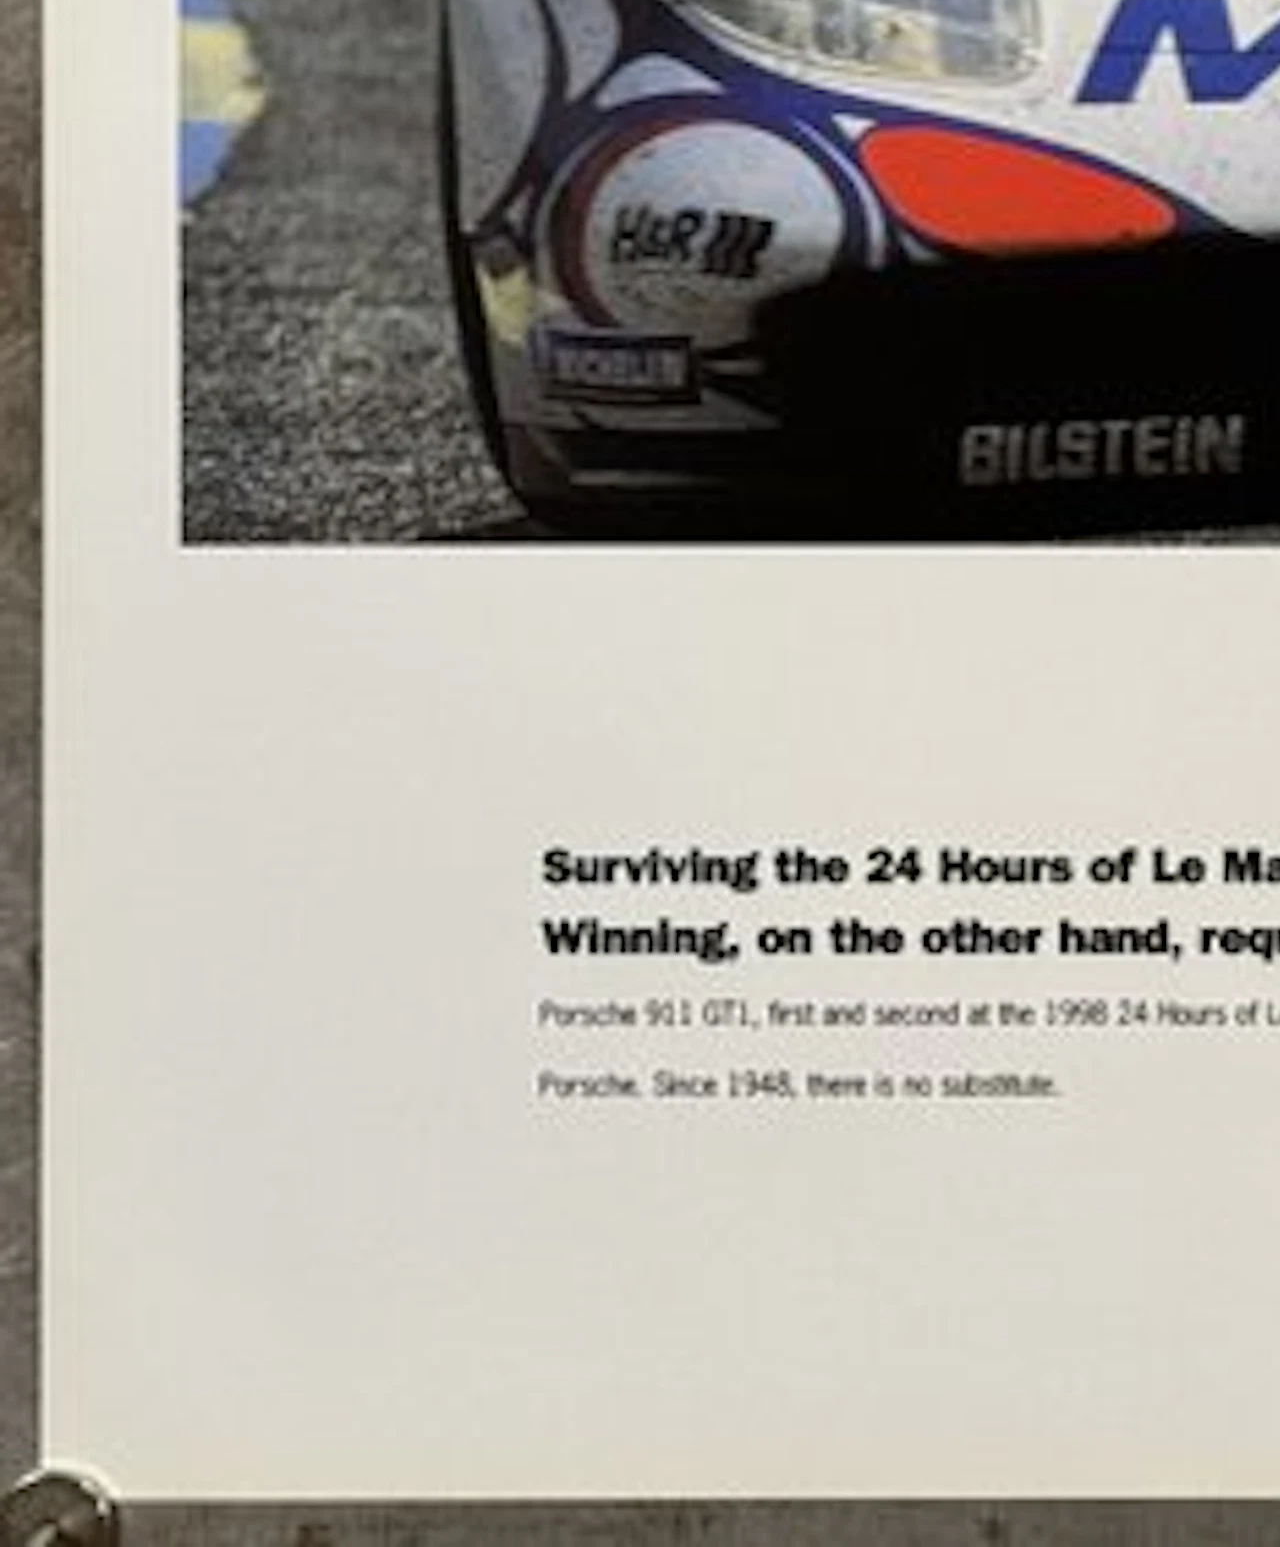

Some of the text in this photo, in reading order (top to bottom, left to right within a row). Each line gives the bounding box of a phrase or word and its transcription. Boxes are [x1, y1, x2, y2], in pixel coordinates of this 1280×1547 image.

[957, 414, 1245, 486] BILSTEIN
[542, 846, 761, 895] Surviving
[772, 846, 851, 886] the
[865, 845, 924, 885] 24
[938, 846, 1075, 885] Hours
[1086, 845, 1139, 885] of
[1151, 846, 1208, 886] Le
[540, 916, 742, 966] Winning,
[756, 926, 814, 956] on
[827, 916, 906, 956] the
[920, 917, 1044, 956] other
[1057, 917, 1183, 962] hand,
[538, 998, 638, 1028] Porsche
[644, 998, 693, 1028] 911
[767, 998, 816, 1028] first
[822, 999, 867, 1028] and
[873, 999, 962, 1028] second
[967, 1002, 992, 1028] at
[998, 999, 1037, 1027] the
[1046, 997, 1110, 1027] 1998
[1117, 997, 1150, 1027] 24
[1156, 998, 1229, 1028] Hours
[1234, 998, 1260, 1028] of
[652, 1068, 719, 1099] Since
[806, 1070, 868, 1100] there
[873, 1070, 896, 1100] is
[903, 1074, 933, 1100] no
